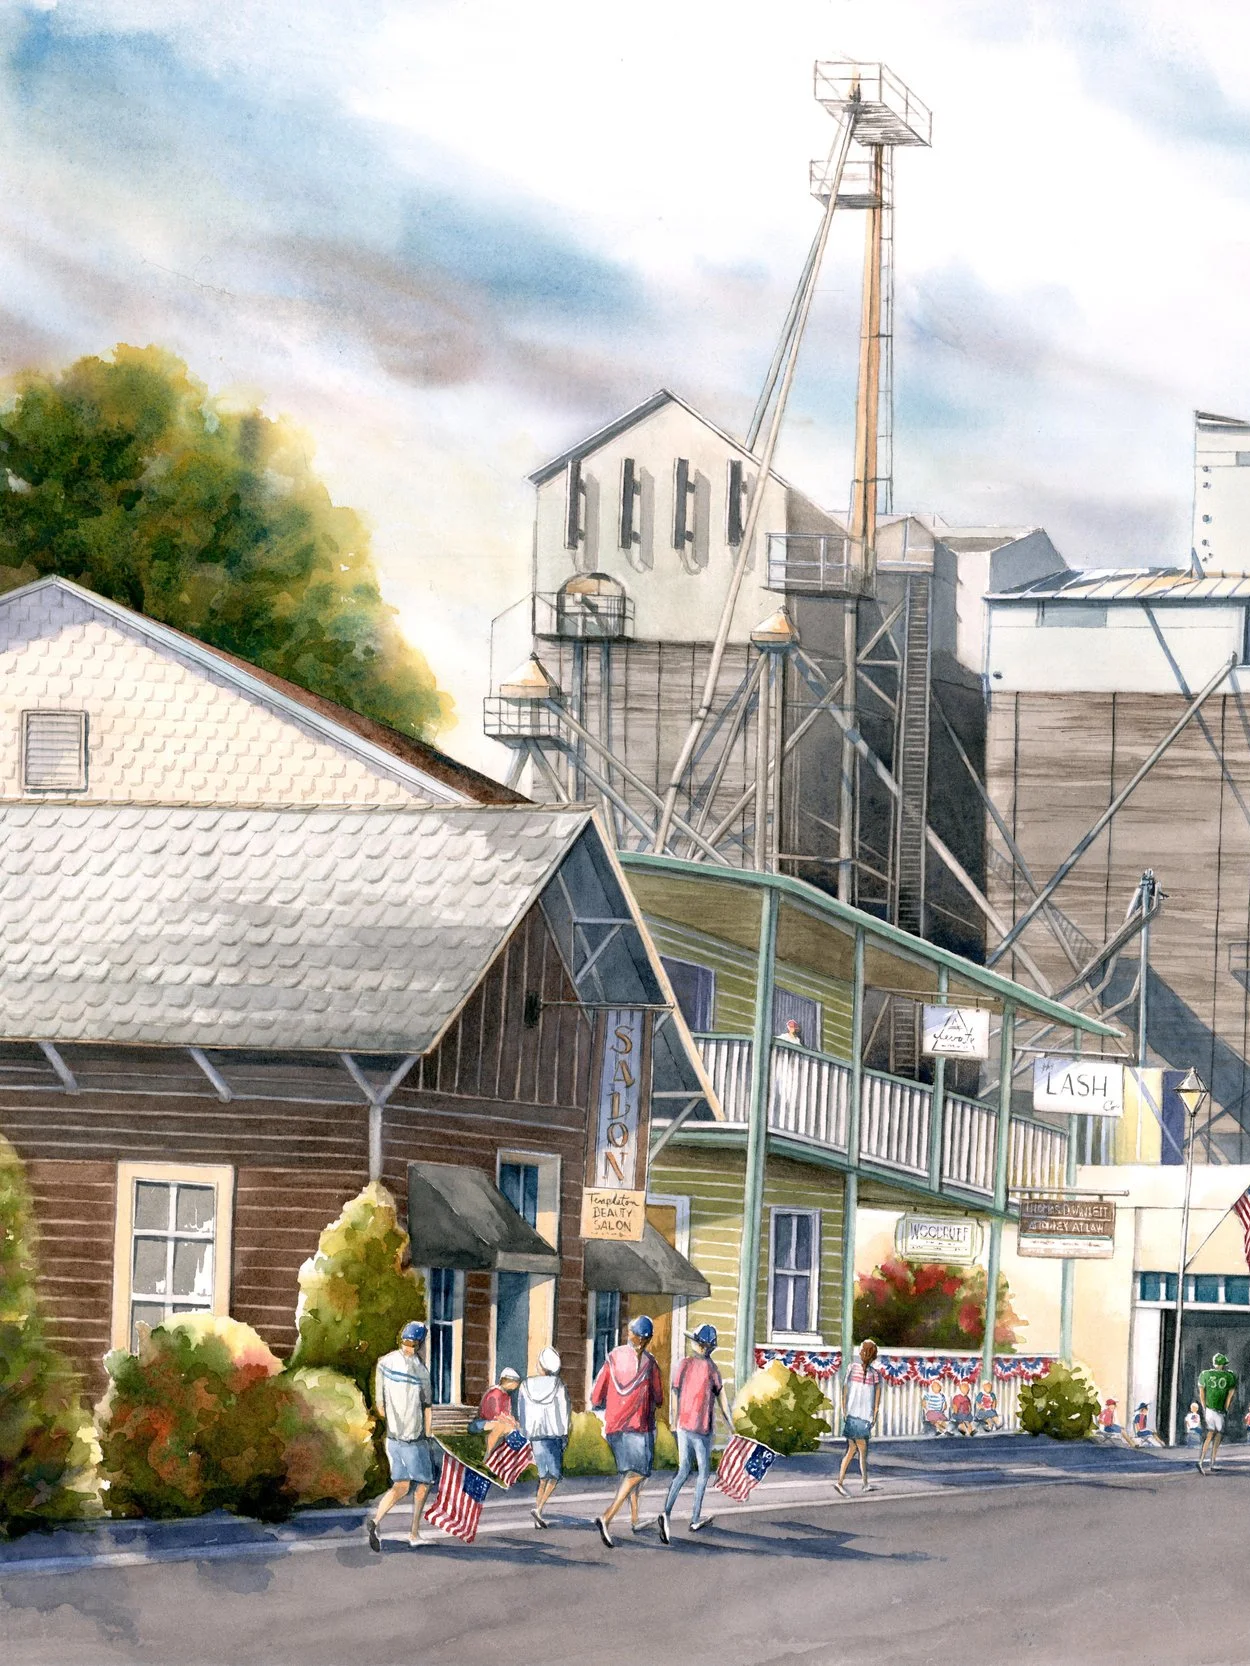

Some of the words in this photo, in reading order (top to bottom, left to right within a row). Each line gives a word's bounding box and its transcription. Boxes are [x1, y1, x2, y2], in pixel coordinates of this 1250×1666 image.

[1046, 1072, 1108, 1097] LASH
[602, 1025, 636, 1182] SALON
[585, 1192, 640, 1207] Templeton
[593, 1219, 632, 1233] SALON
[910, 1222, 969, 1242] WOODRUFF
